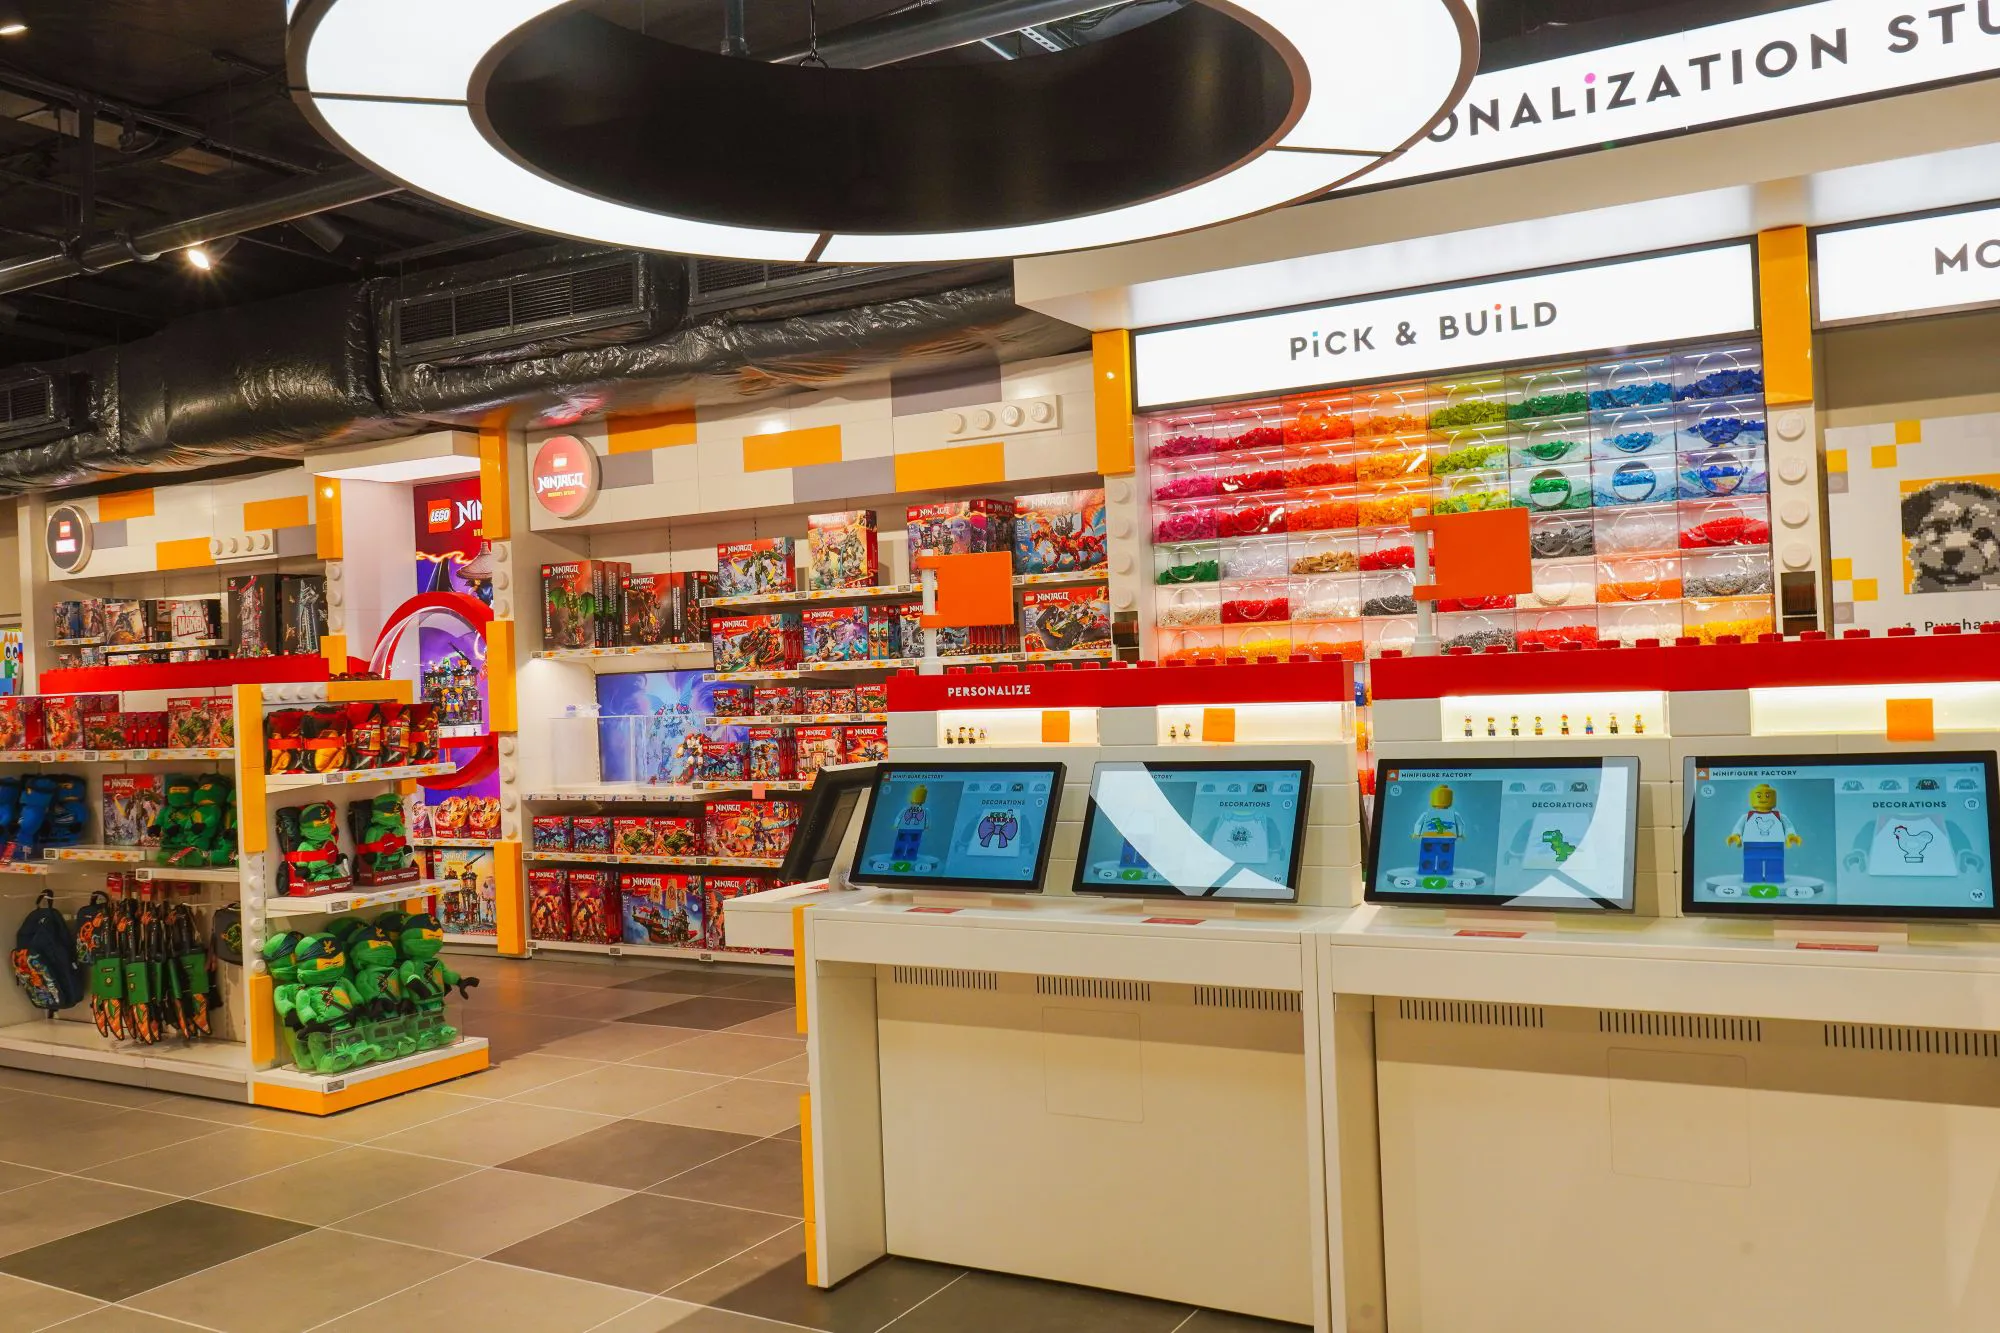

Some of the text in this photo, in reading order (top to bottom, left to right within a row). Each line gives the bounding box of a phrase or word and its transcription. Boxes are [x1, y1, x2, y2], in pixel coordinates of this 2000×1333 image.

[1290, 301, 1557, 361] PiCK & BUiLD
[537, 472, 587, 494] NINJAGO
[430, 508, 451, 523] LEGO
[727, 544, 754, 554] NINJAGO
[552, 565, 580, 576] NINJAGO
[1036, 592, 1070, 603] NINJAGO
[721, 620, 749, 629] NINJAGO
[948, 685, 1031, 697] PERSONALIZE
[1872, 801, 1947, 809] DECORATIONS
